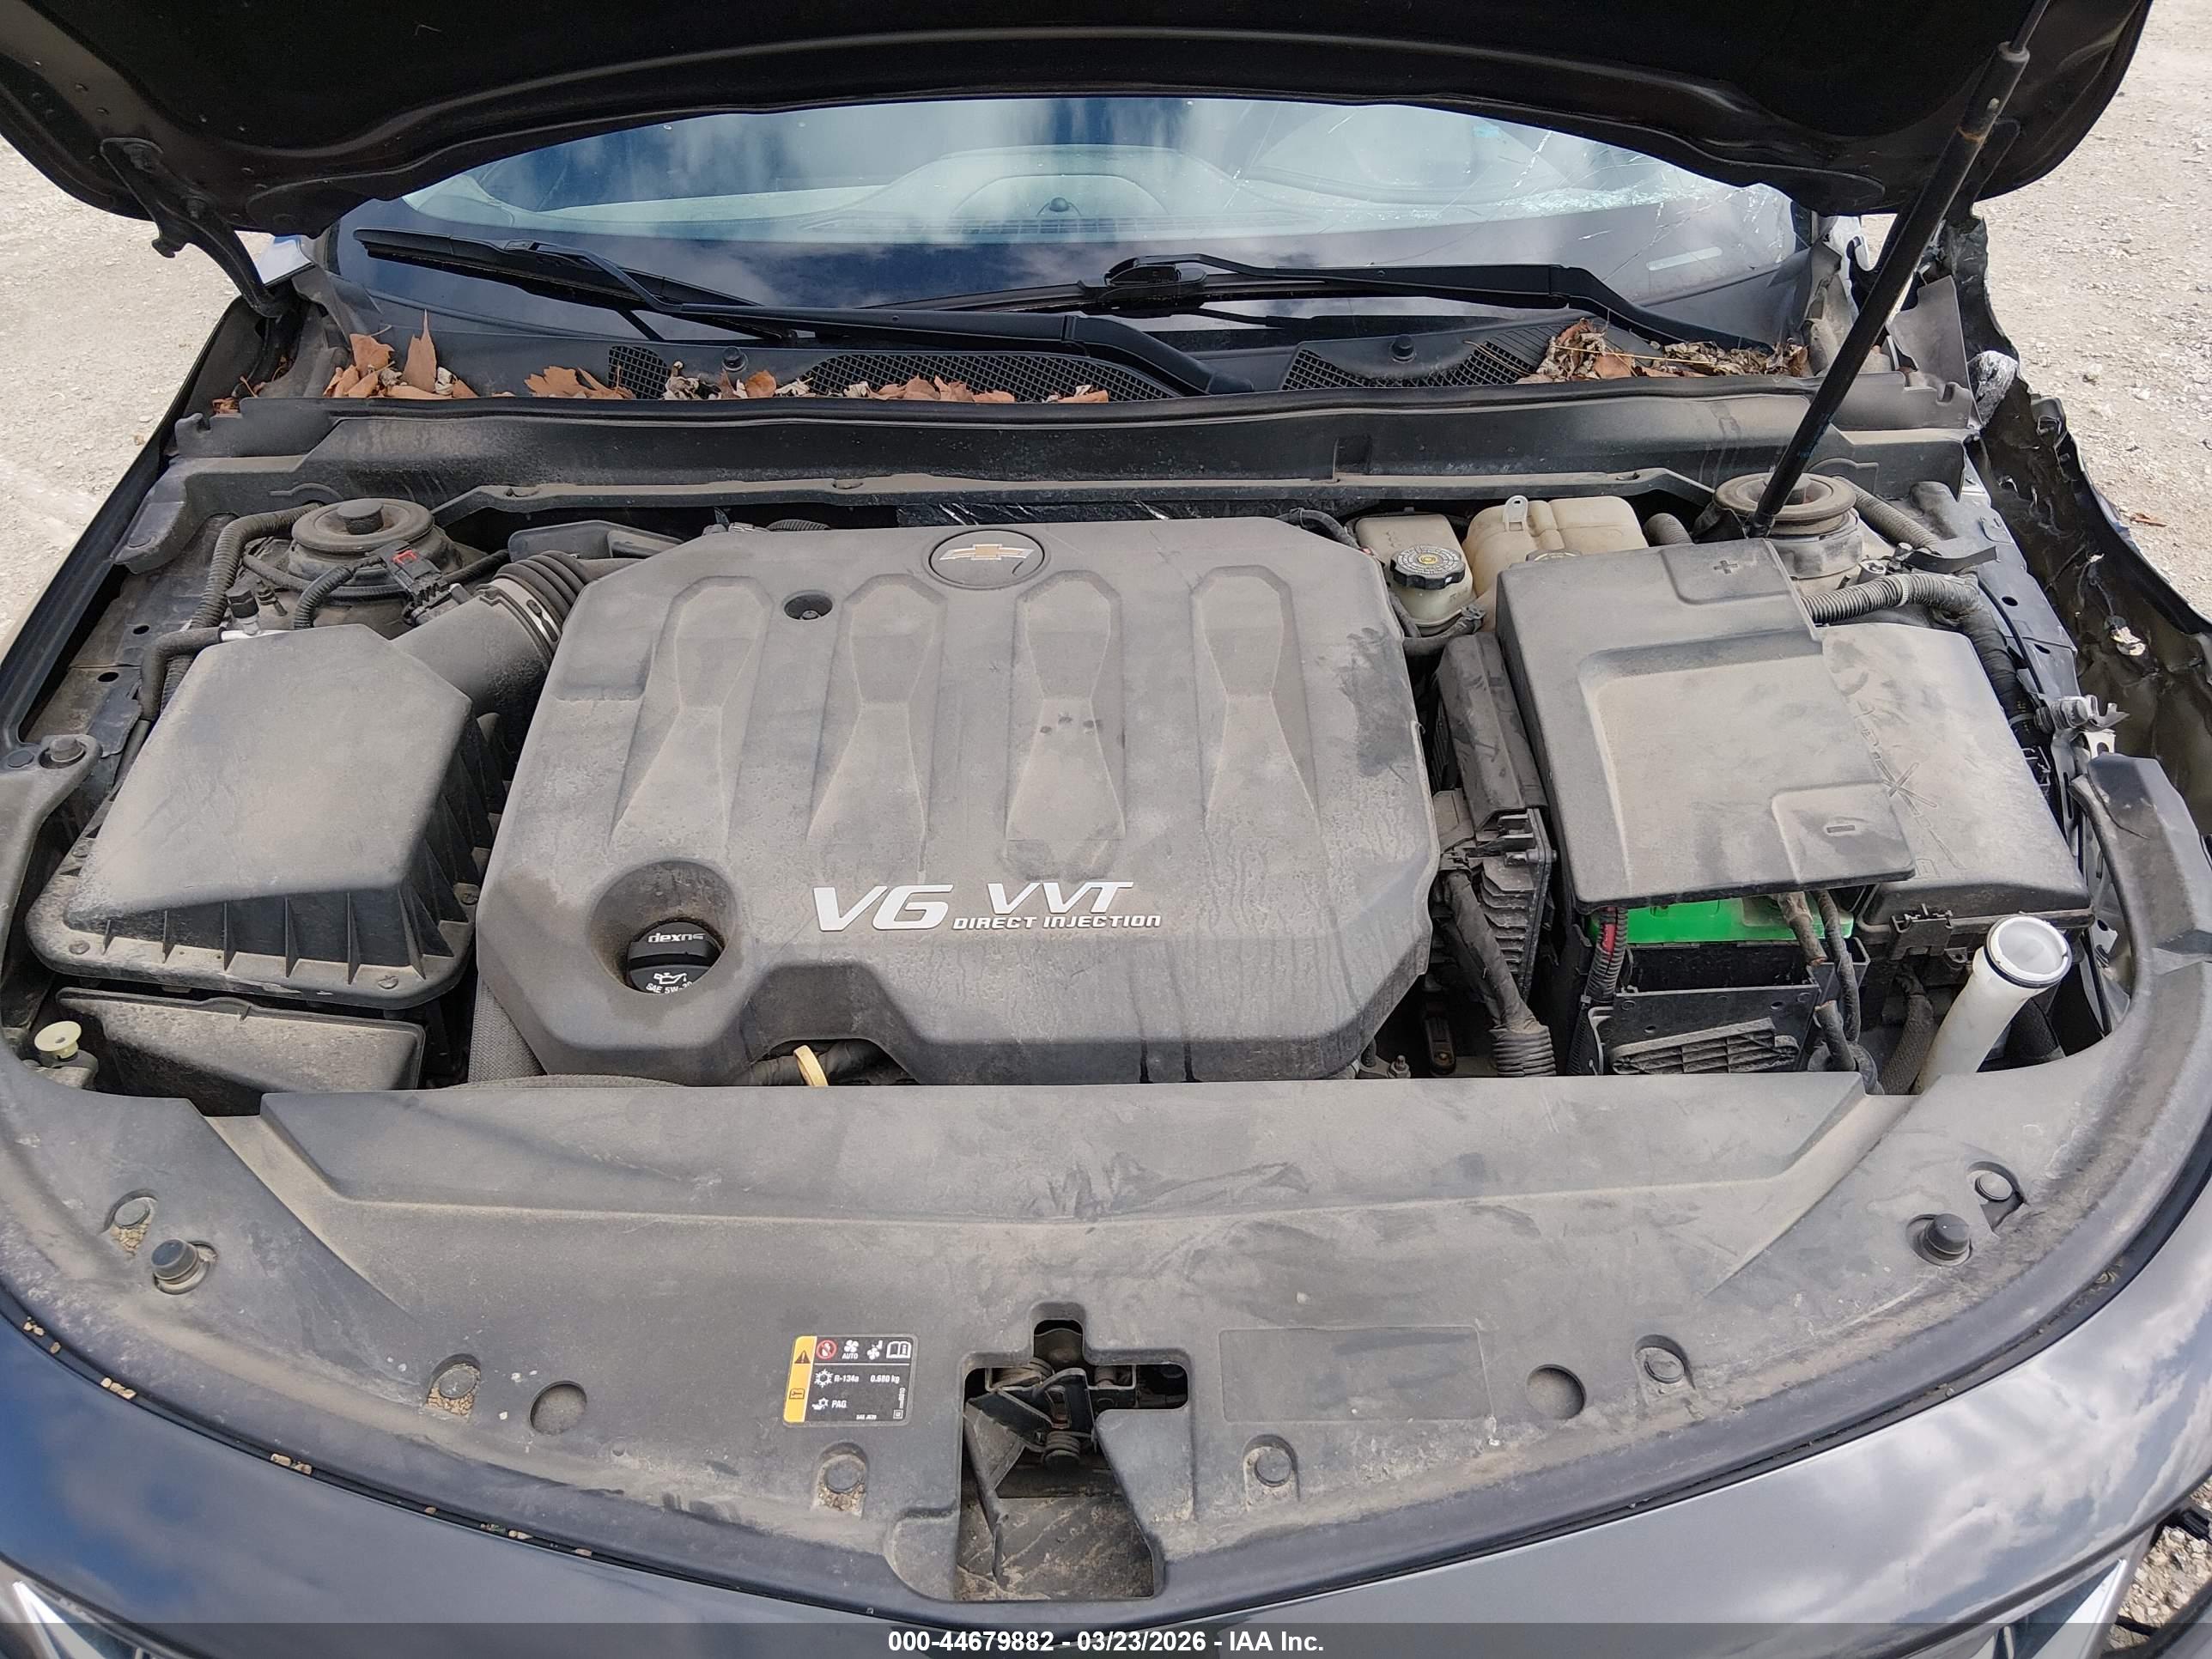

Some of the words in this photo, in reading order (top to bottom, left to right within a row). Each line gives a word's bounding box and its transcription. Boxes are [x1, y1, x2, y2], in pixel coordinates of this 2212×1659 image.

[988, 881, 1134, 915] VVT
[813, 884, 954, 931] V6
[952, 915, 1037, 930] DIRECT
[1042, 915, 1162, 929] INJECTION
[646, 982, 663, 994] SAE
[834, 1374, 860, 1383] R-134a
[891, 1374, 901, 1384] kg
[831, 1400, 848, 1409] PAG
